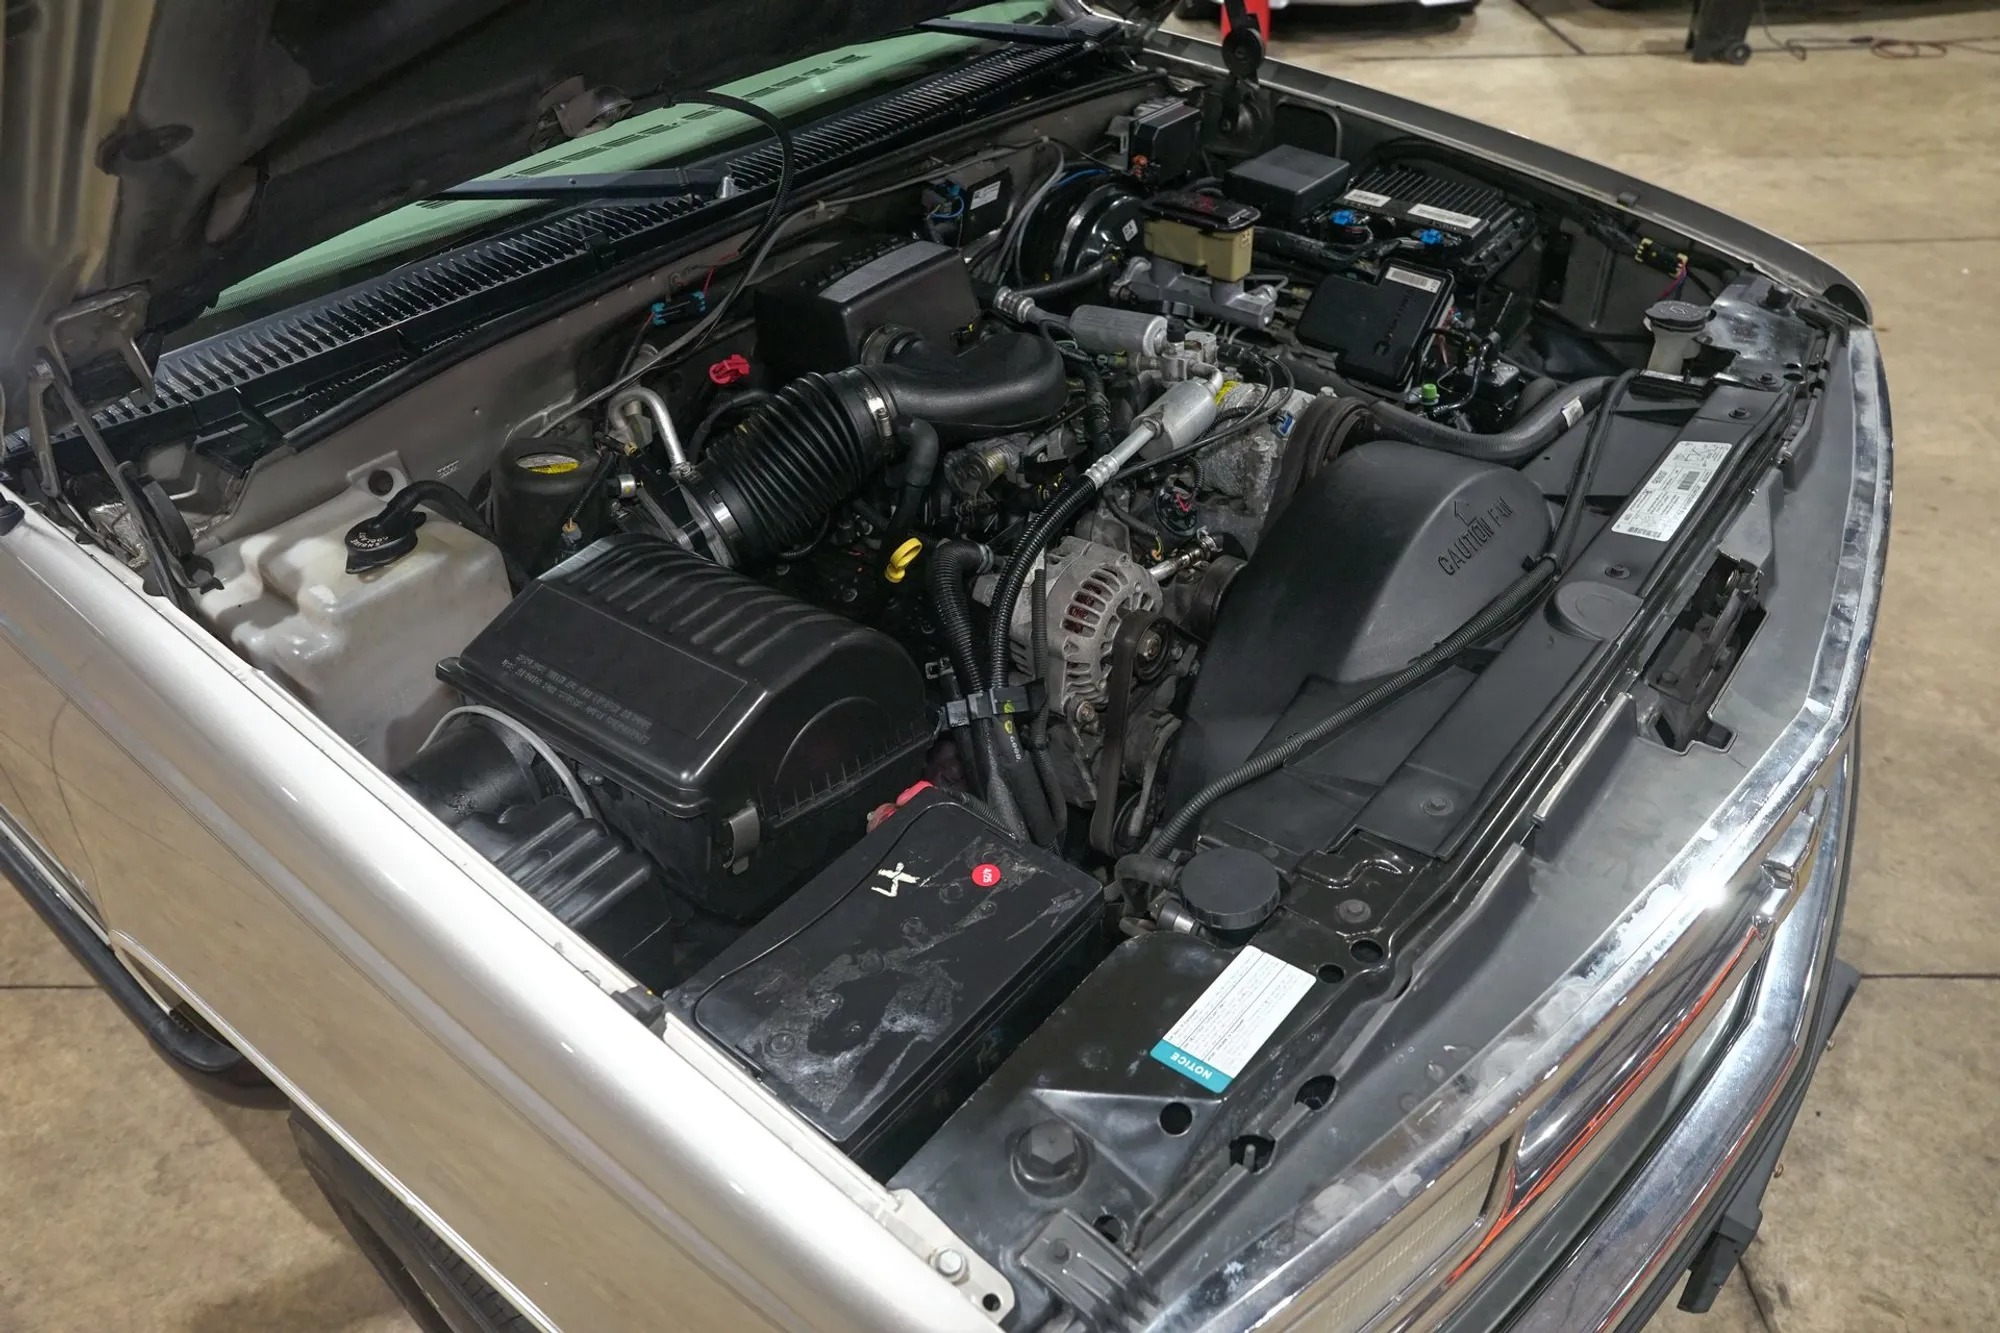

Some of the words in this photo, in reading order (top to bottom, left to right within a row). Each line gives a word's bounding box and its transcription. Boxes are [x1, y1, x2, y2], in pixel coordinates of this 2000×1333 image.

[349, 538, 381, 548] ENGINE
[358, 532, 389, 543] COOLANT
[1438, 516, 1495, 577] CAUTION
[1170, 1052, 1212, 1080] NOTICE
